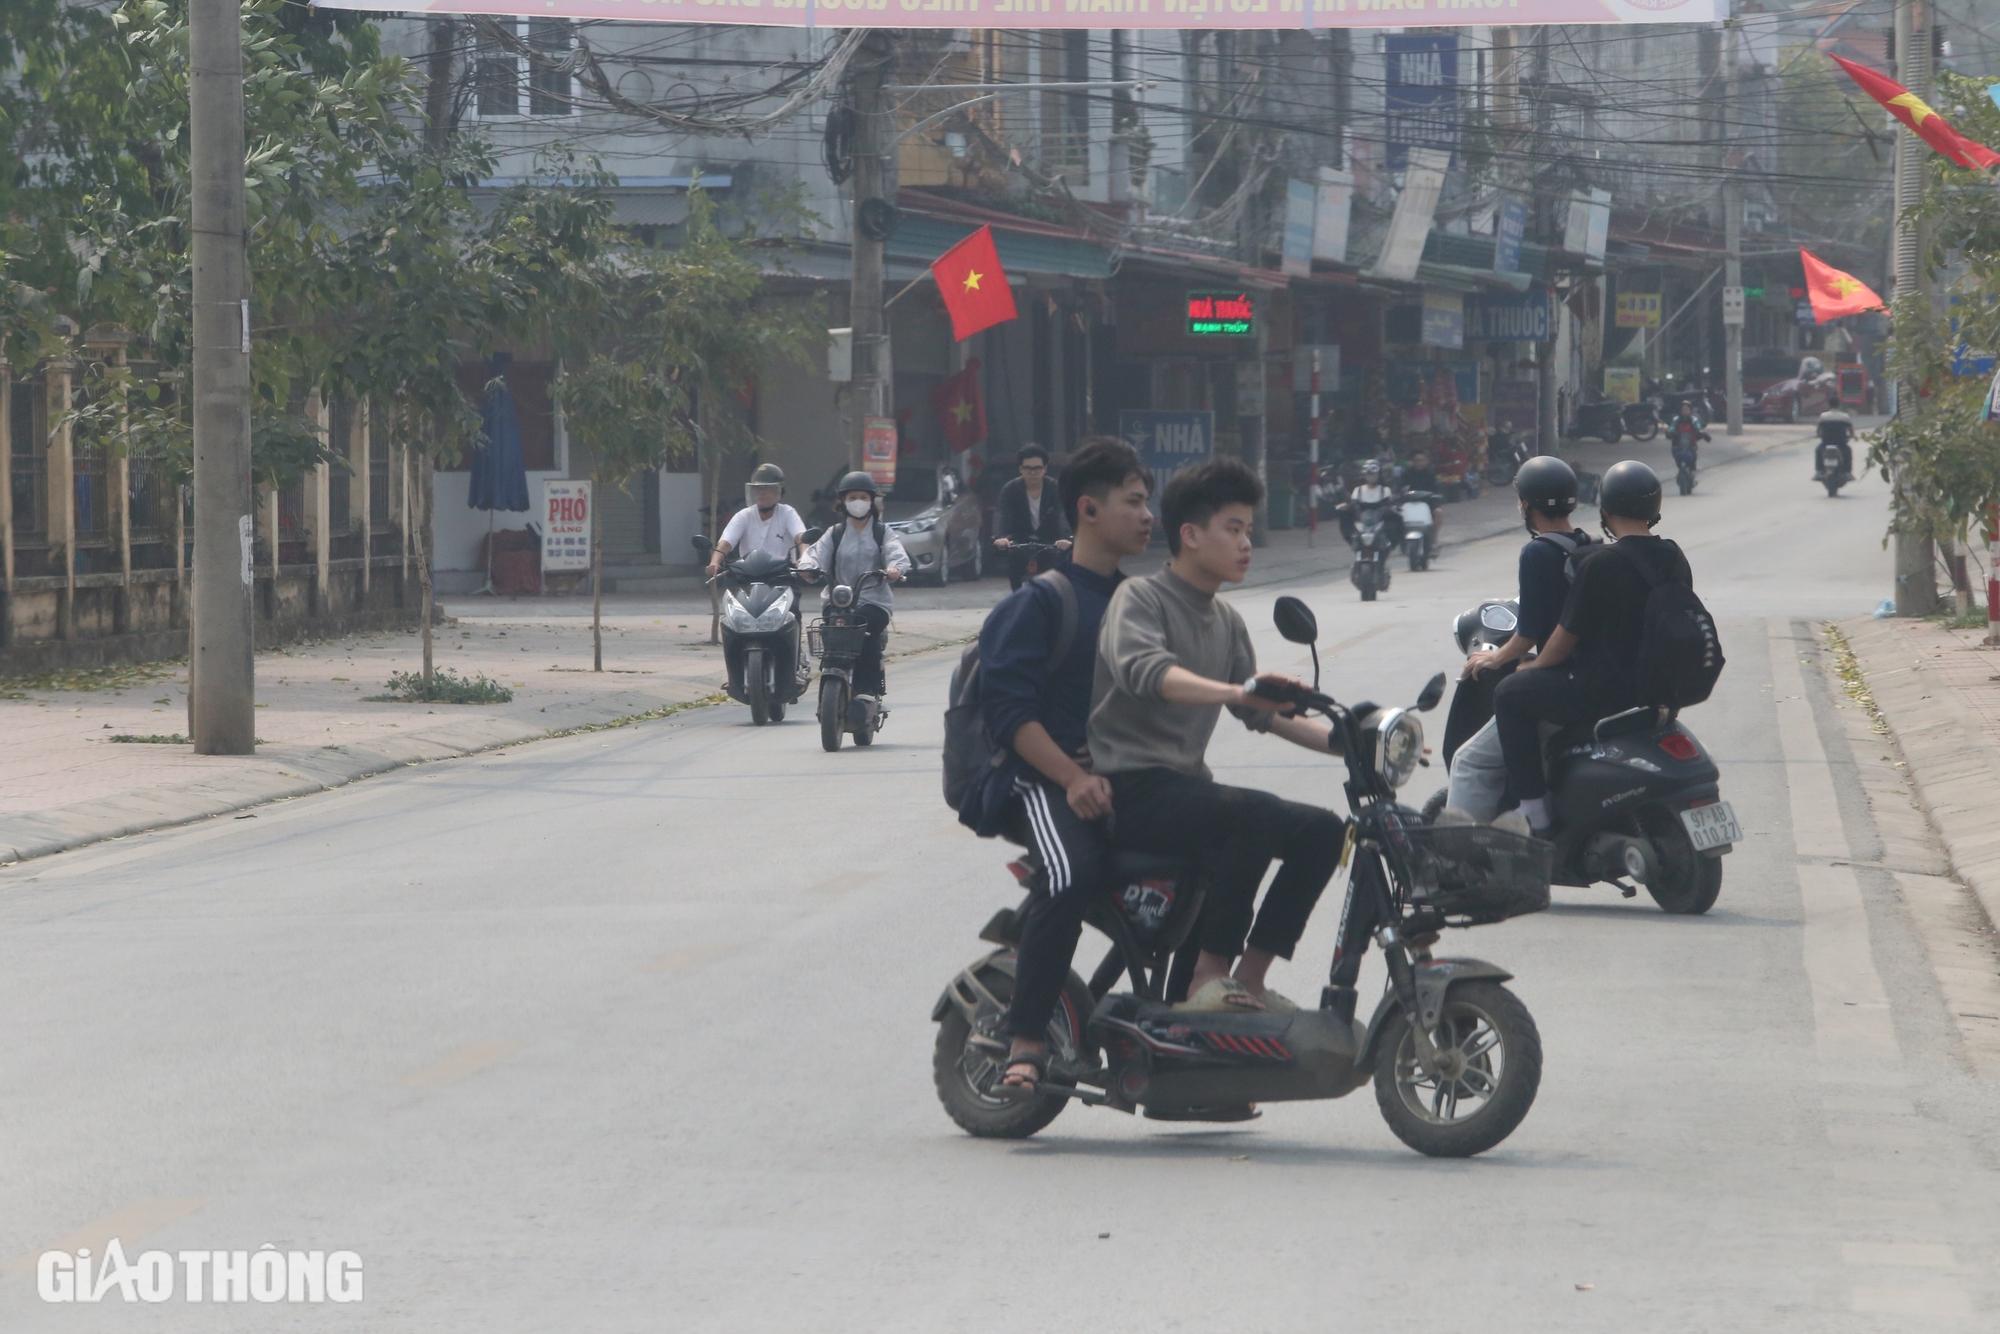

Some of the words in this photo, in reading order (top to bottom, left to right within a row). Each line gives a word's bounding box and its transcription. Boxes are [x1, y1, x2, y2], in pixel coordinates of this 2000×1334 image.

[1400, 42, 1443, 86] NHÀ
[1188, 295, 1213, 319] NHÀ
[1214, 293, 1253, 319] THUỐC
[1488, 294, 1546, 337] THUỐC
[1155, 417, 1204, 454] NHÀ
[548, 487, 587, 522] PHỞ
[1690, 805, 1727, 829] 97-AB
[1693, 821, 1737, 847] 010.27
